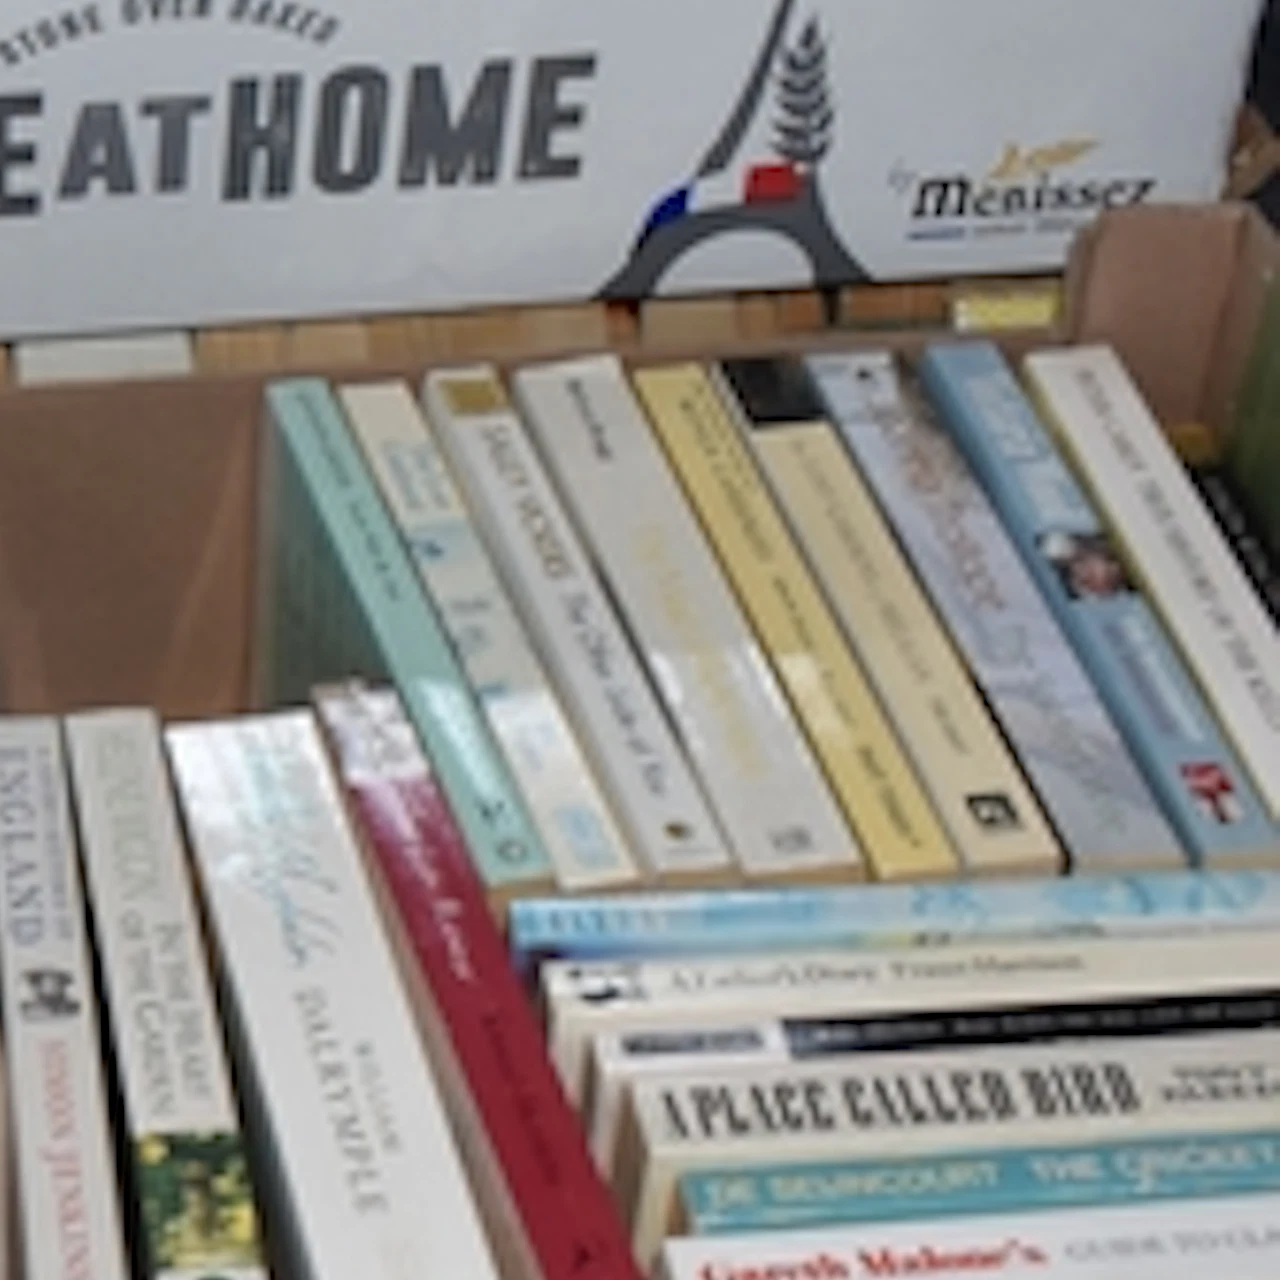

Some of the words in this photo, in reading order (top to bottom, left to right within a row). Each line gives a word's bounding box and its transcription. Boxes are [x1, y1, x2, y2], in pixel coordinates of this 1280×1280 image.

[54, 90, 214, 198] AT
[220, 50, 600, 204] HOME
[293, 984, 390, 1218] DALRYMPLE
[661, 1090, 688, 1140] A
[689, 1080, 838, 1140] PLACE
[840, 1068, 1020, 1127] CALLED
[1024, 1062, 1143, 1116] BIRD
[1028, 1150, 1106, 1182] THE
